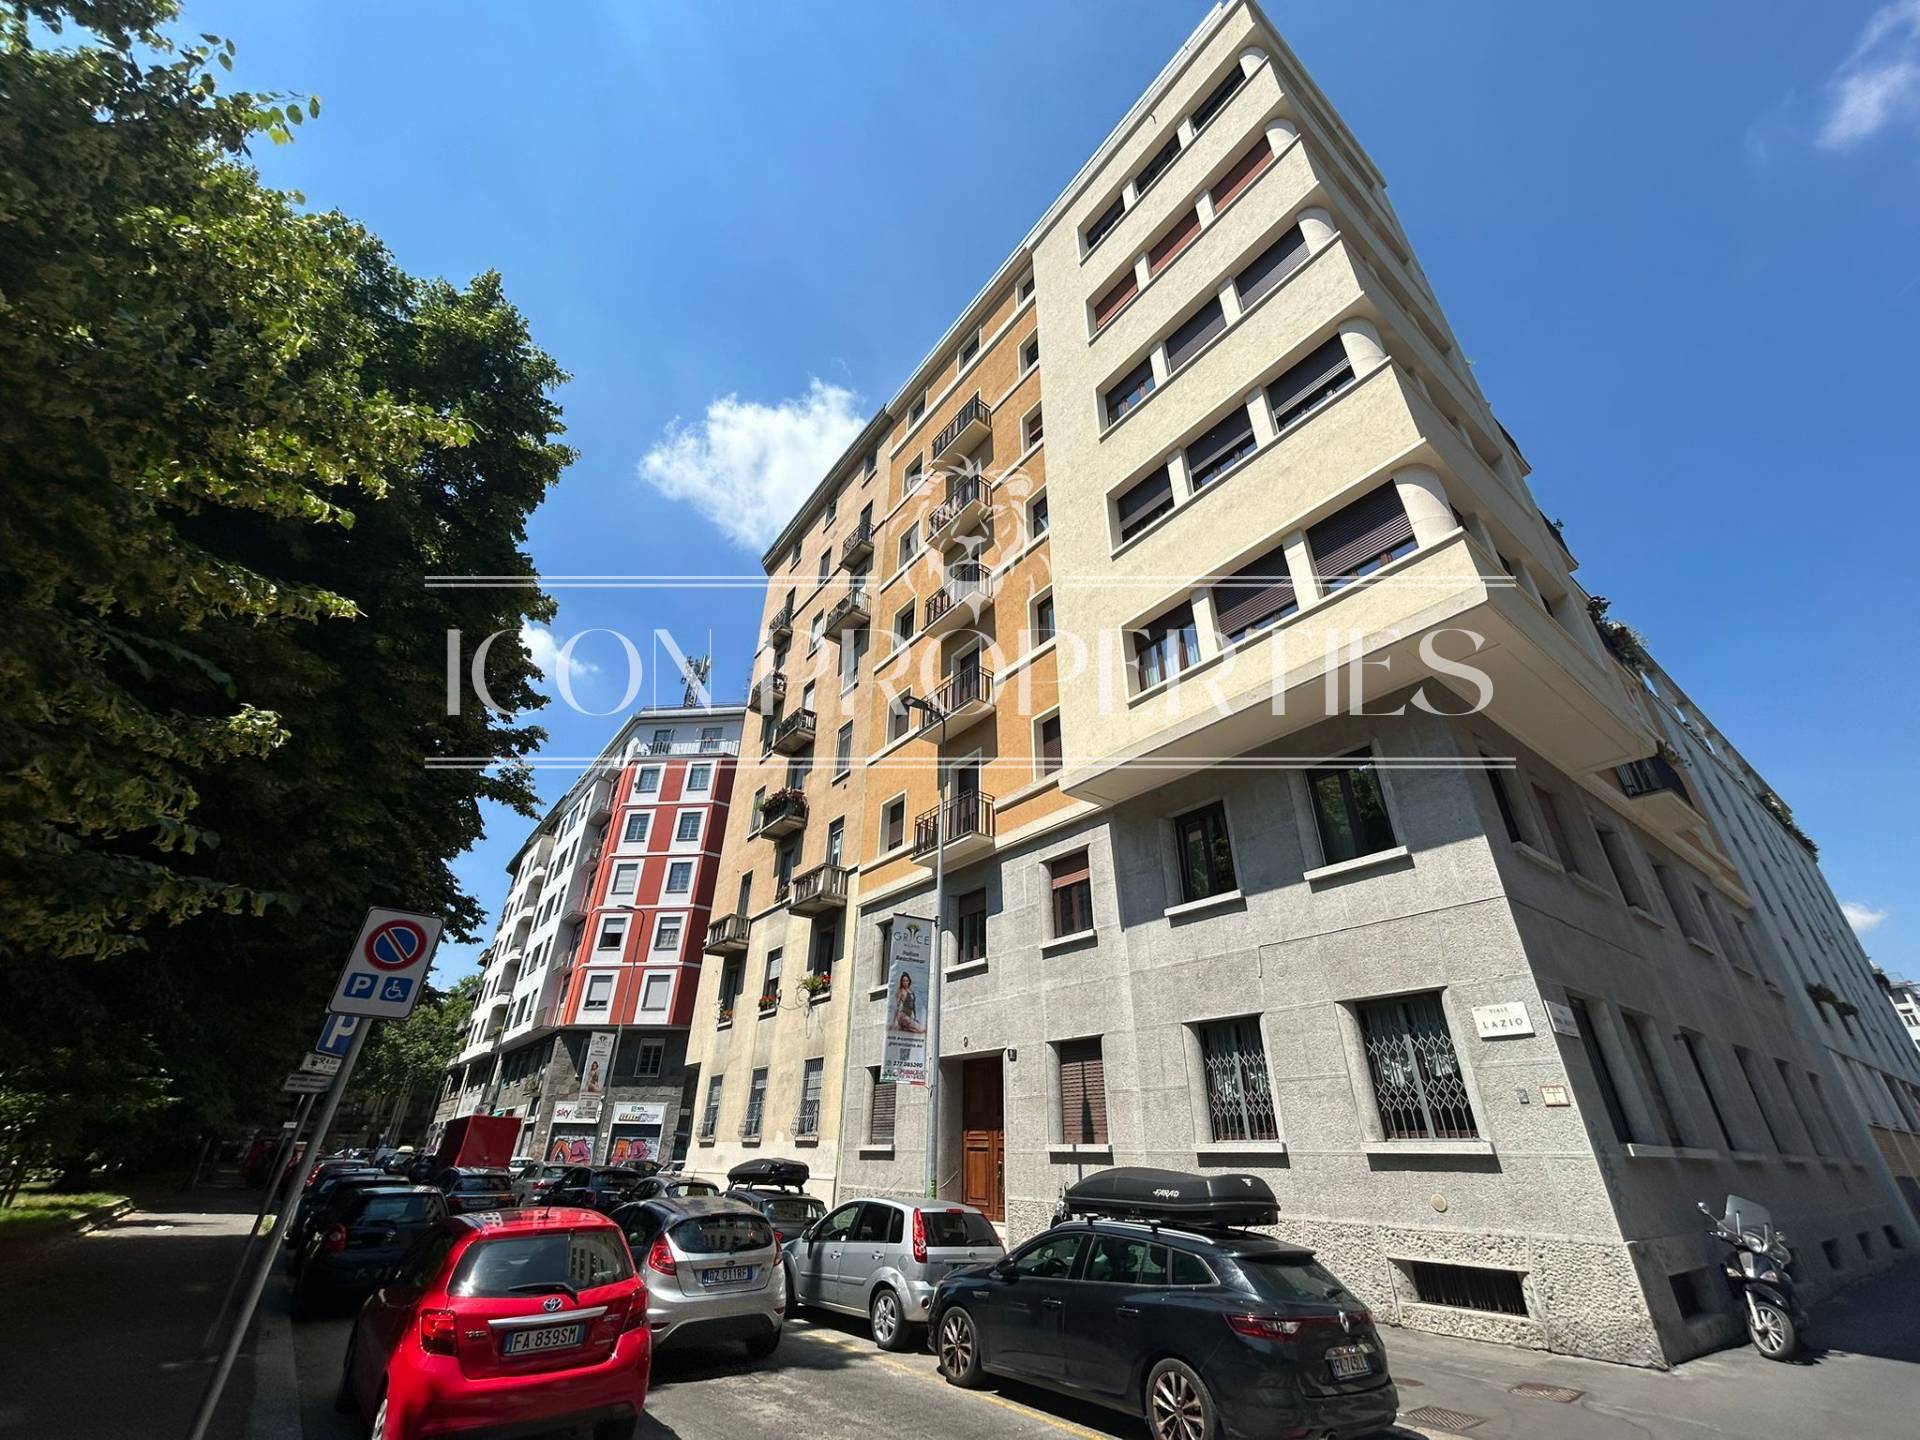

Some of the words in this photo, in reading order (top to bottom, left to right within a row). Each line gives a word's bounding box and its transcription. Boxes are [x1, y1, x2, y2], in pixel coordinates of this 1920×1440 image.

[351, 976, 371, 995] P
[1482, 1017, 1524, 1030] LAZIO
[556, 1107, 572, 1119] sky
[1152, 1188, 1180, 1199] FARAD
[513, 1331, 532, 1350] FA
[534, 1327, 577, 1347] 839SM
